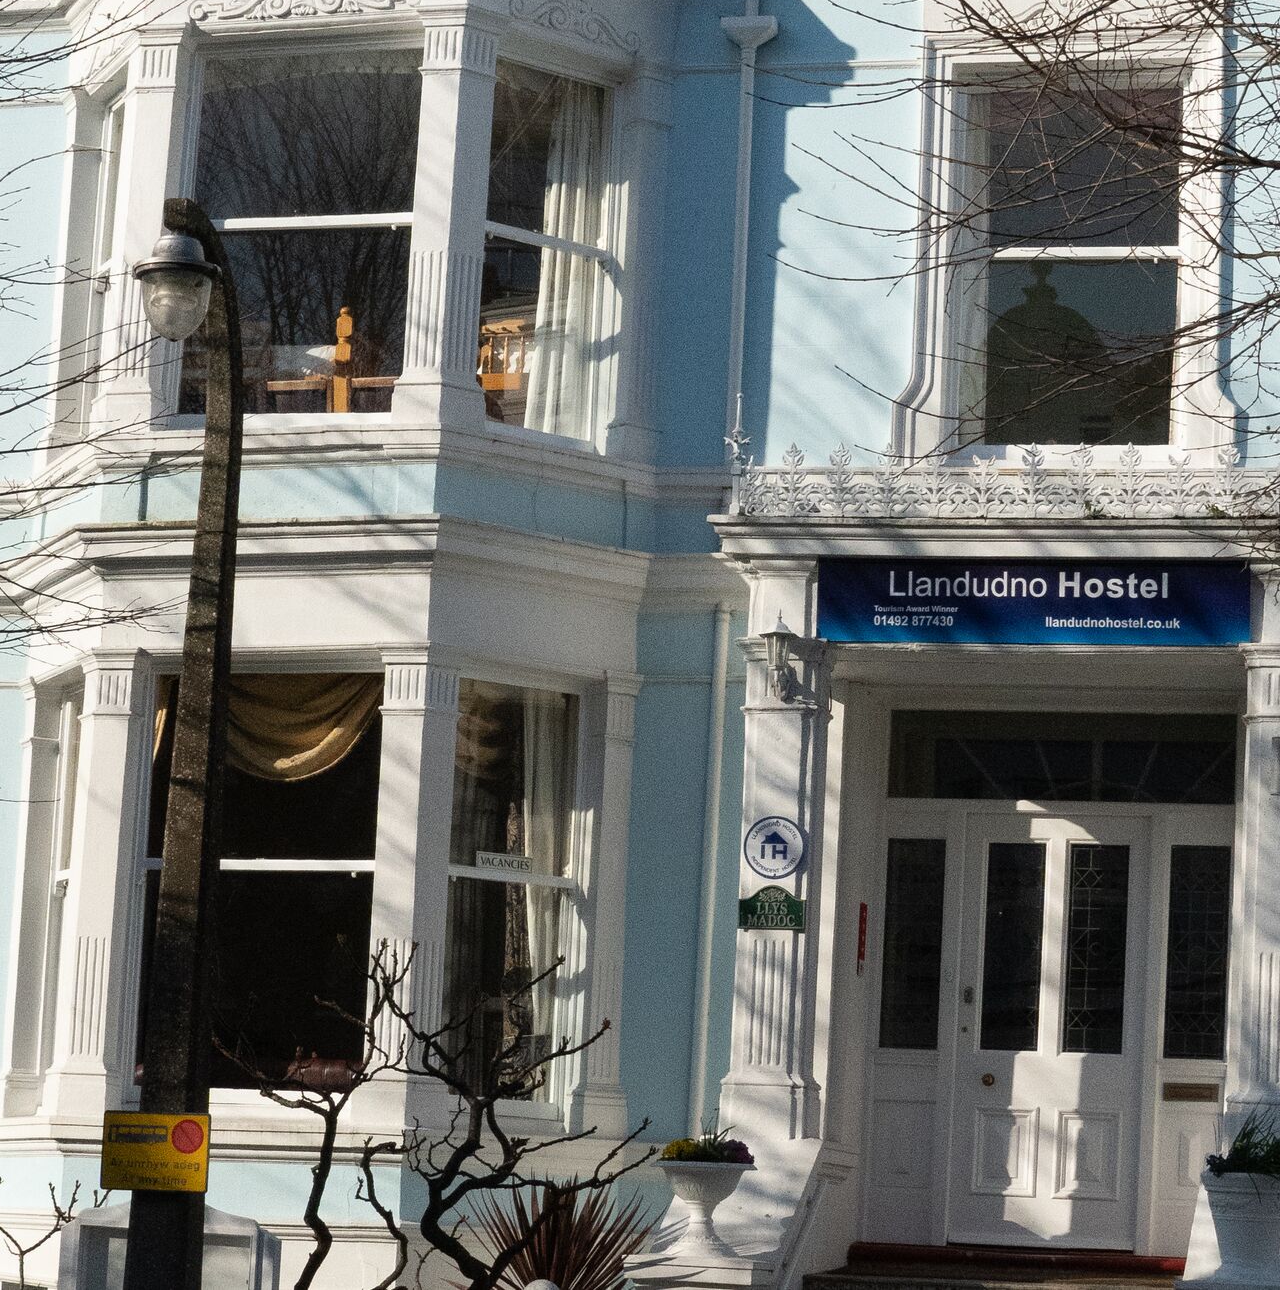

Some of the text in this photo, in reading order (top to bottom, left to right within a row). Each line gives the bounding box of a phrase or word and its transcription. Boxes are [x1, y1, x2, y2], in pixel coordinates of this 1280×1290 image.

[888, 570, 1169, 599] Llandudno Hostel
[874, 605, 959, 613] Tourism Award Winner
[873, 615, 954, 627] 01492 877430
[1045, 616, 1181, 629] llandudnohostel.co.uk
[751, 820, 798, 841] LLANDUDNO HOSTEL
[480, 856, 530, 870] VACANCIES
[751, 855, 798, 873] INDEPENDENT HOSTEL
[756, 902, 788, 915] LLYS
[747, 913, 796, 927] MADOC
